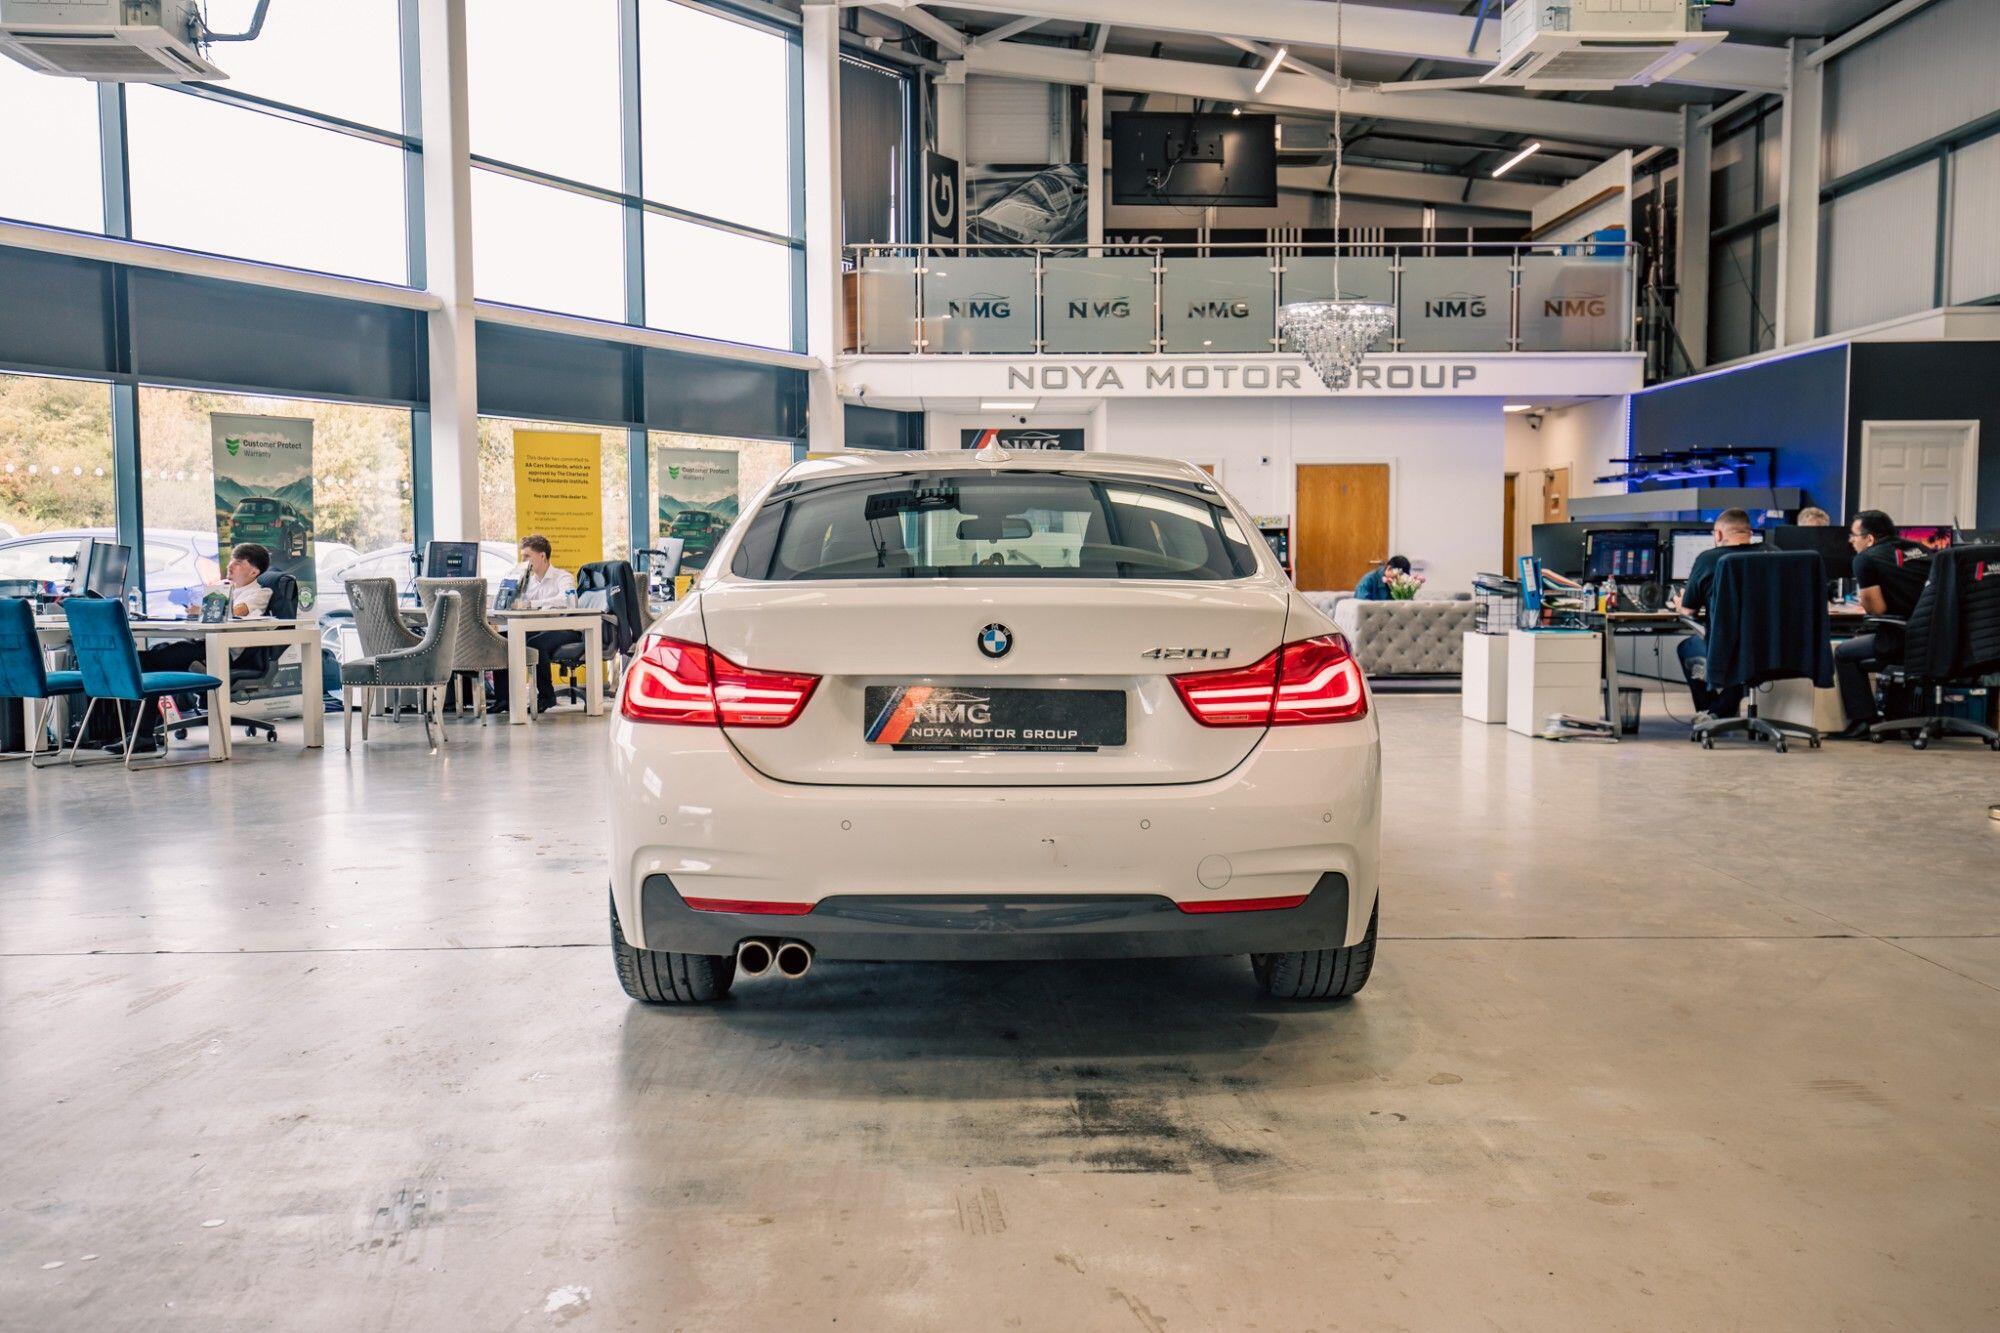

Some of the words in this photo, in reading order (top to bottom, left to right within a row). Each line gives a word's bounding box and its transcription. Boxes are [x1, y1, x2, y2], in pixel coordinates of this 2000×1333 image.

[948, 301, 1011, 318] NMG
[1068, 302, 1130, 318] NMG
[1187, 302, 1250, 318] NMG
[1425, 301, 1487, 318] NMG
[1543, 300, 1606, 317] NMG
[1008, 365, 1124, 389] NOYA
[1146, 365, 1301, 389] MOTOR
[243, 440, 275, 448] Customer
[277, 441, 302, 450] Protect
[244, 450, 271, 458] Warranty
[1141, 648, 1231, 659] 420d
[914, 703, 991, 724] NMG
[911, 728, 953, 738] NOYA
[960, 728, 1016, 739] MOTOR
[1023, 729, 1078, 740] GROUP
